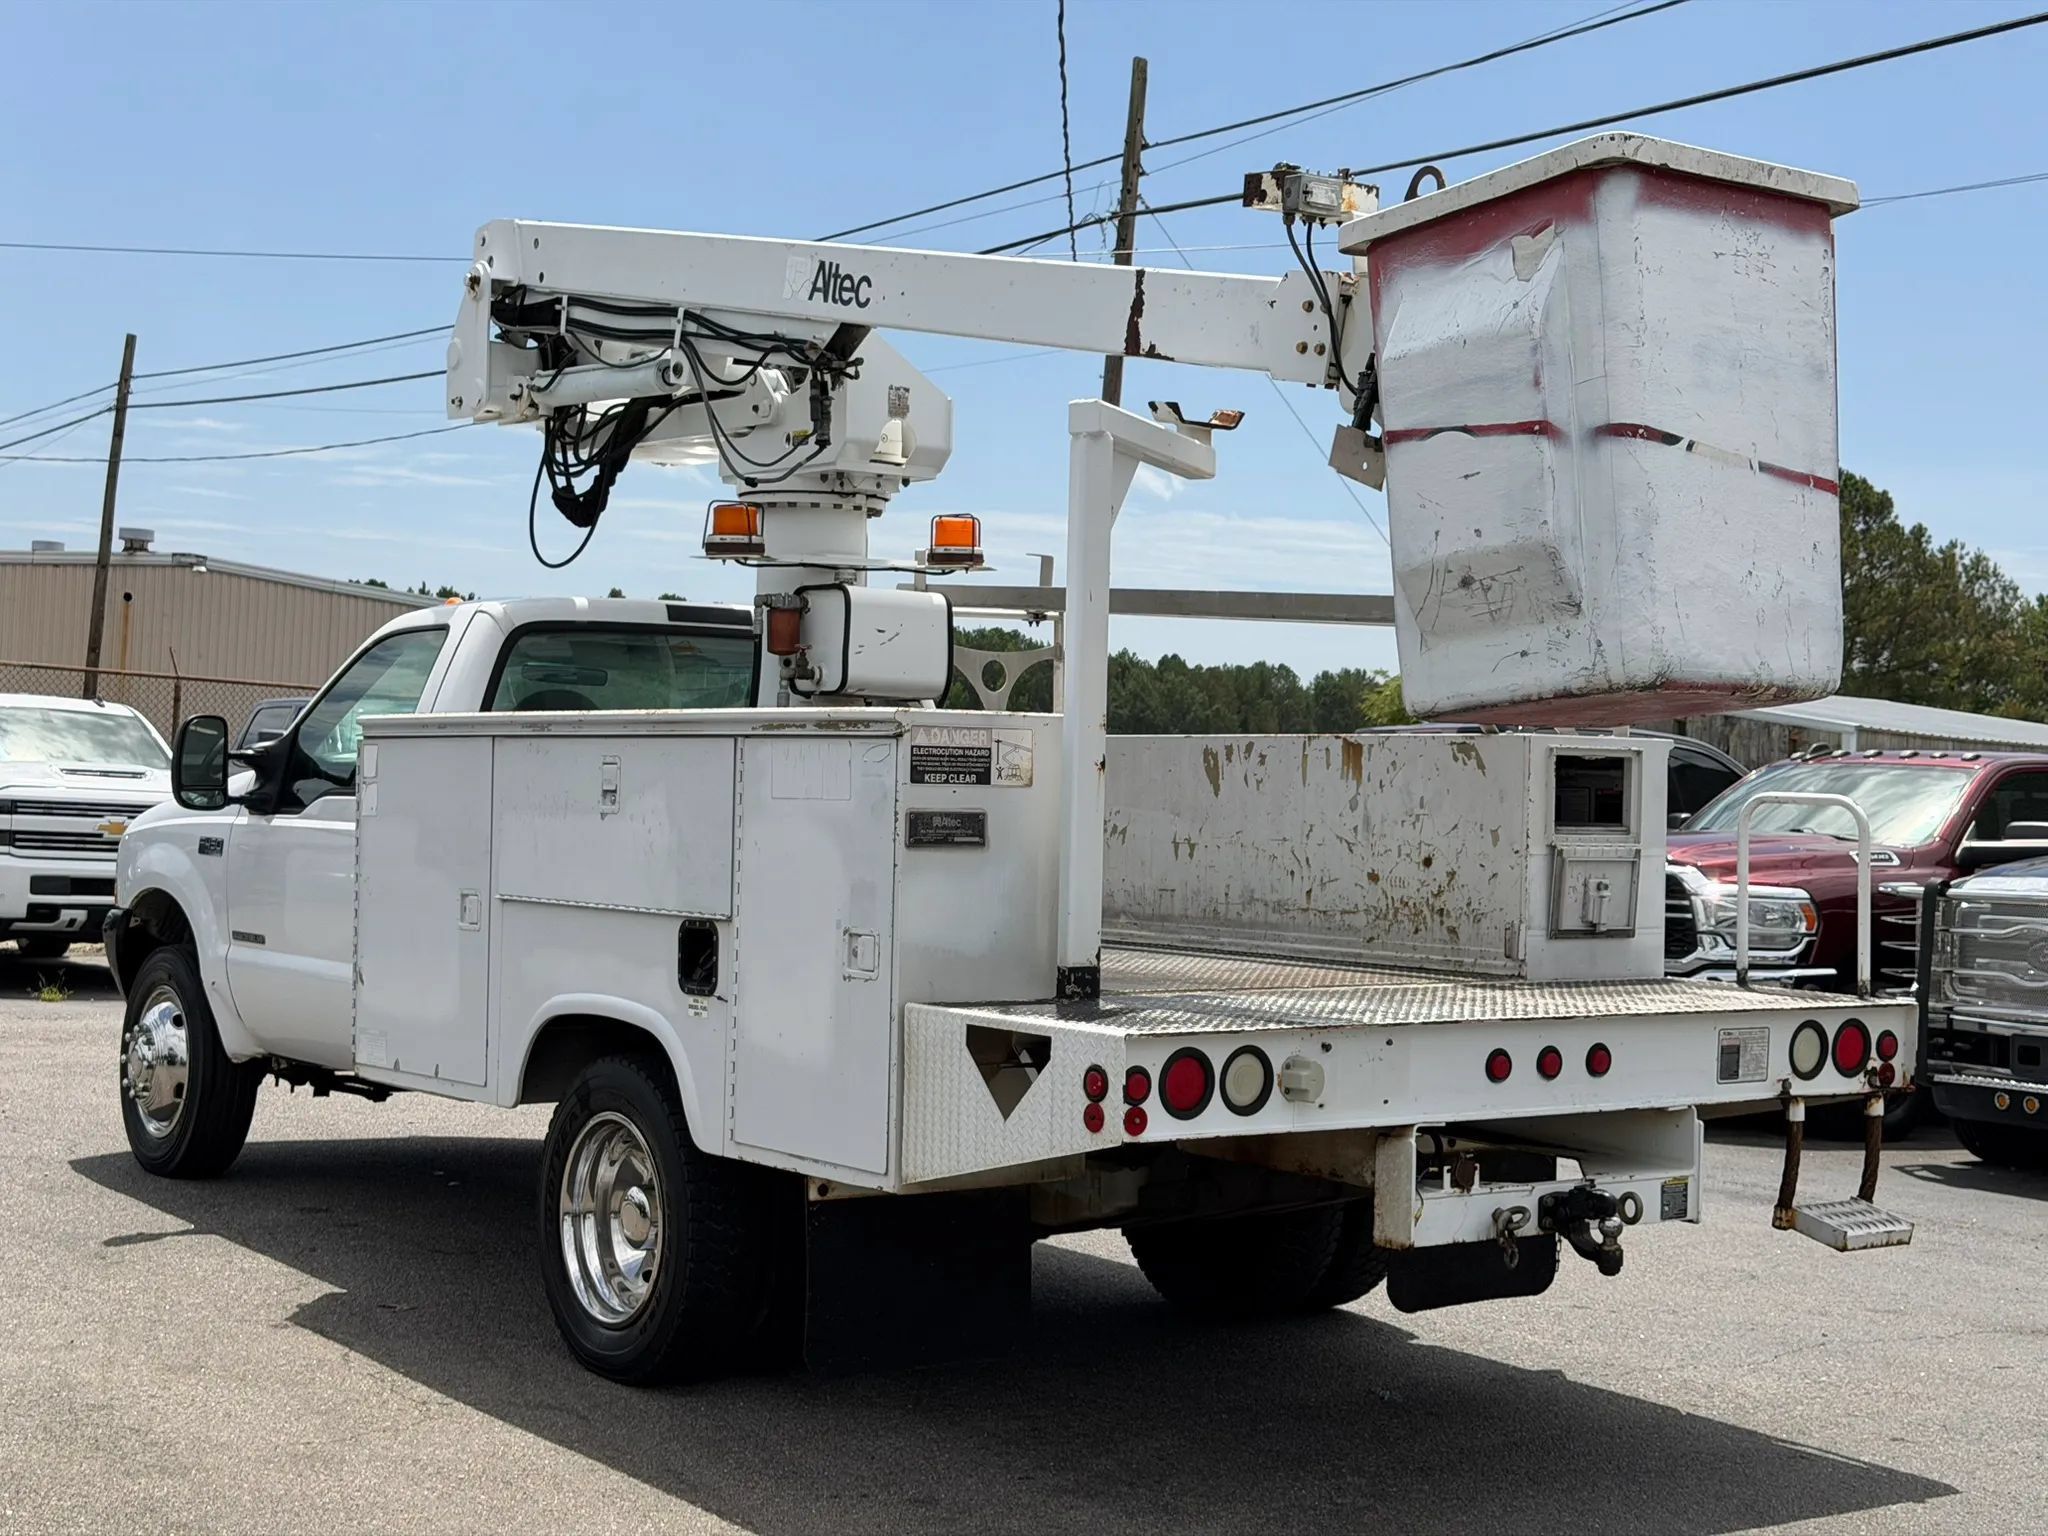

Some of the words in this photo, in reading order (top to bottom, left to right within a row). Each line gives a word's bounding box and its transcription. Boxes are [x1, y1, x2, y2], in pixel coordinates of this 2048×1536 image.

[808, 259, 872, 309] Altec
[931, 728, 988, 746] DANGER
[912, 747, 964, 756] ELECTROCUTION
[964, 748, 990, 757] HAZARD
[924, 773, 948, 783] KEEP
[948, 773, 977, 784] CLEAR
